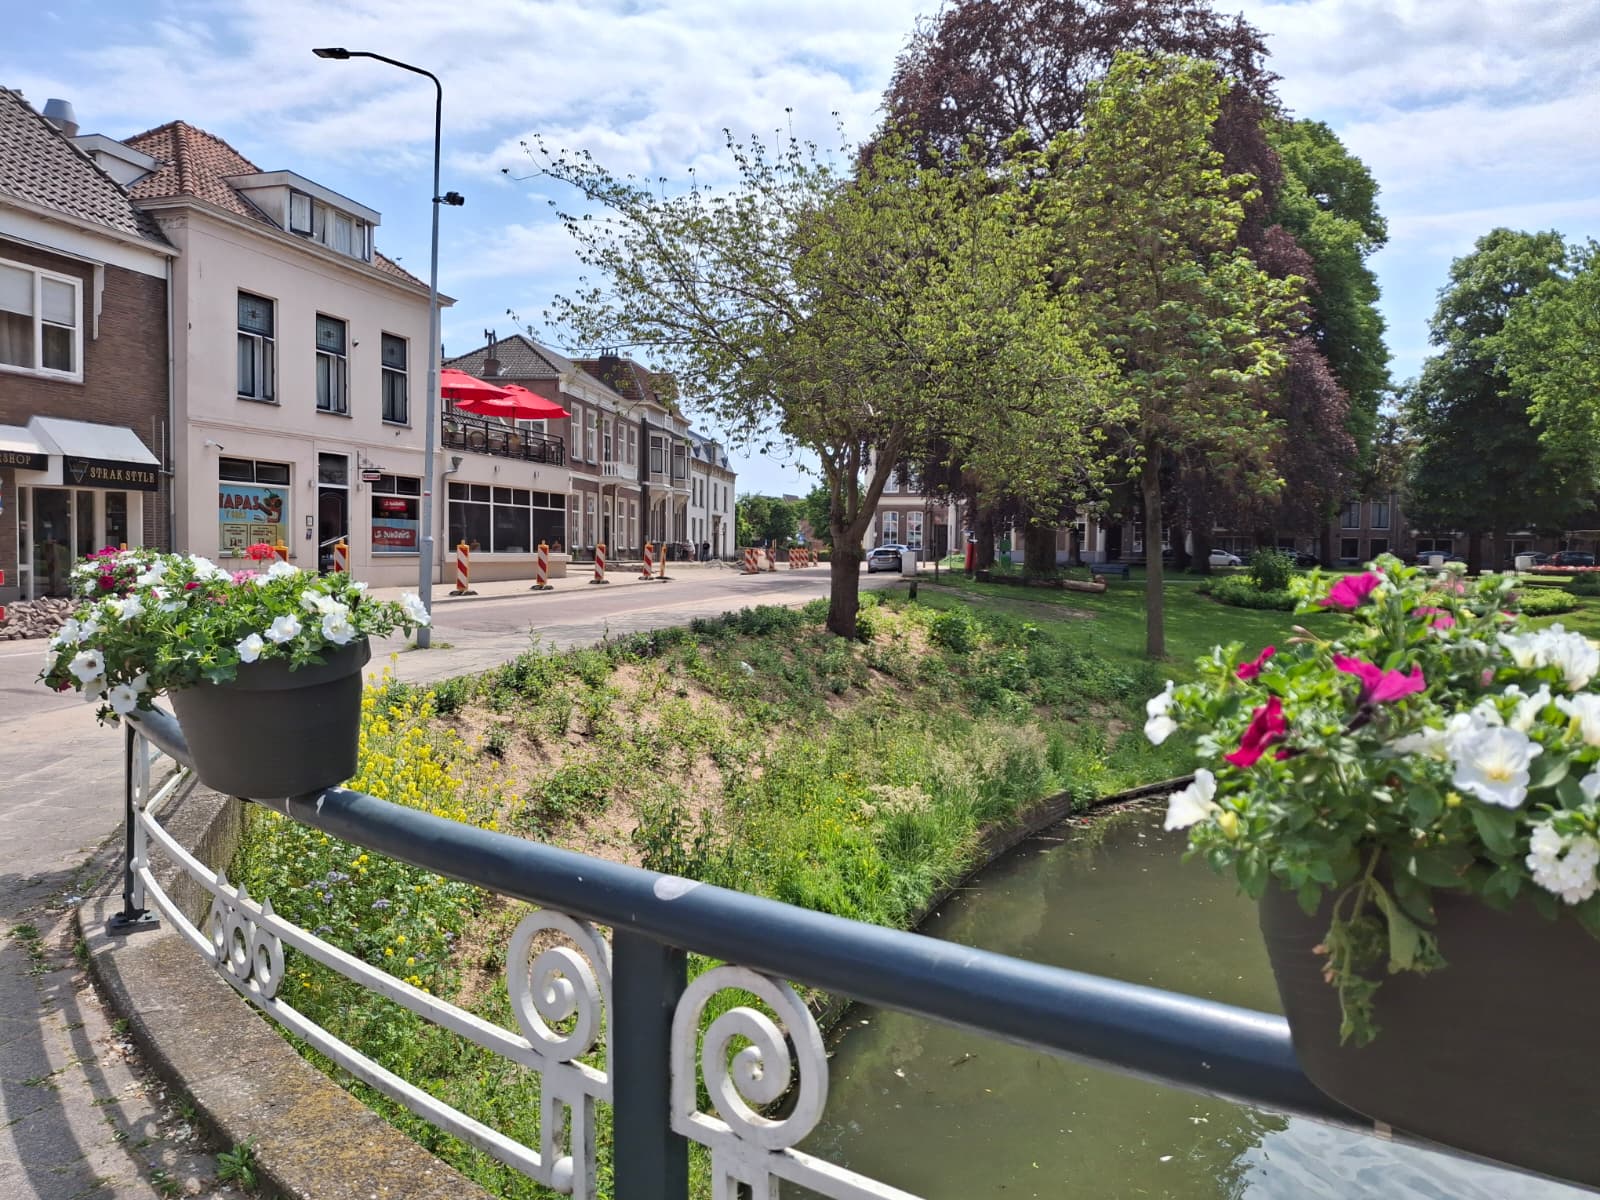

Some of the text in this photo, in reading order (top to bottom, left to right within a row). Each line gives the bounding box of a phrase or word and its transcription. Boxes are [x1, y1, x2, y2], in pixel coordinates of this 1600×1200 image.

[90, 466, 155, 483] STRAK STYLE
[219, 492, 259, 510] TAPAS
